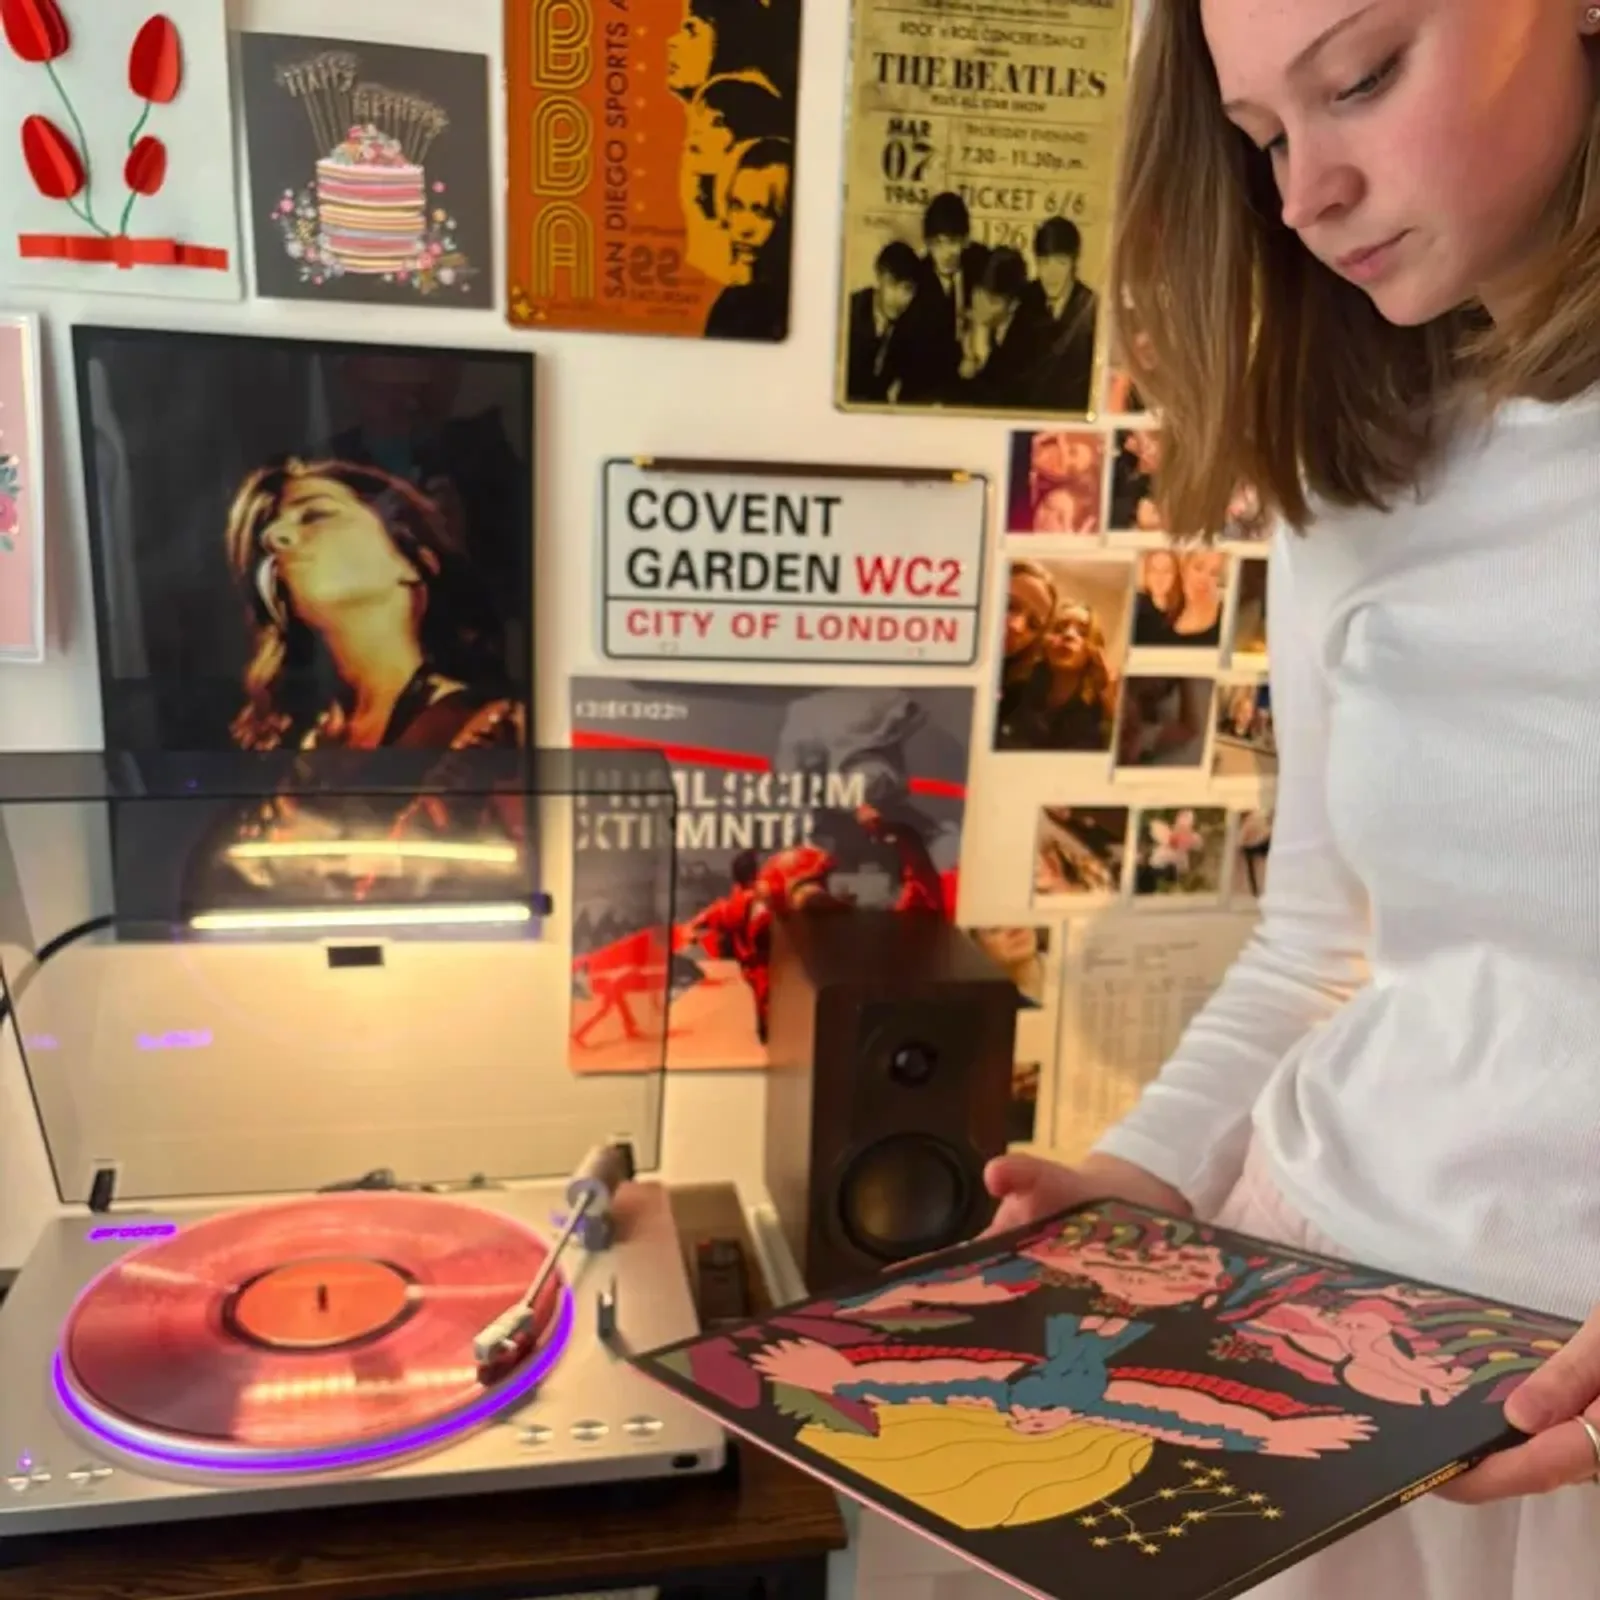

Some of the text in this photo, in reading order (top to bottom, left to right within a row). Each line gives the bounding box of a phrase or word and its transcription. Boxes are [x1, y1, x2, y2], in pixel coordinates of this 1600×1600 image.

[605, 21, 629, 128] SPORTS
[873, 52, 1108, 100] THE BEATLES
[887, 118, 932, 139] MAR
[604, 138, 629, 232] DIEGO
[882, 140, 934, 182] 07
[956, 183, 1038, 211] TICKET
[604, 241, 627, 298] SAN
[626, 487, 843, 537] COVENT
[626, 547, 962, 598] GARDEN WC2
[626, 608, 959, 644] CITY OF LONDON
